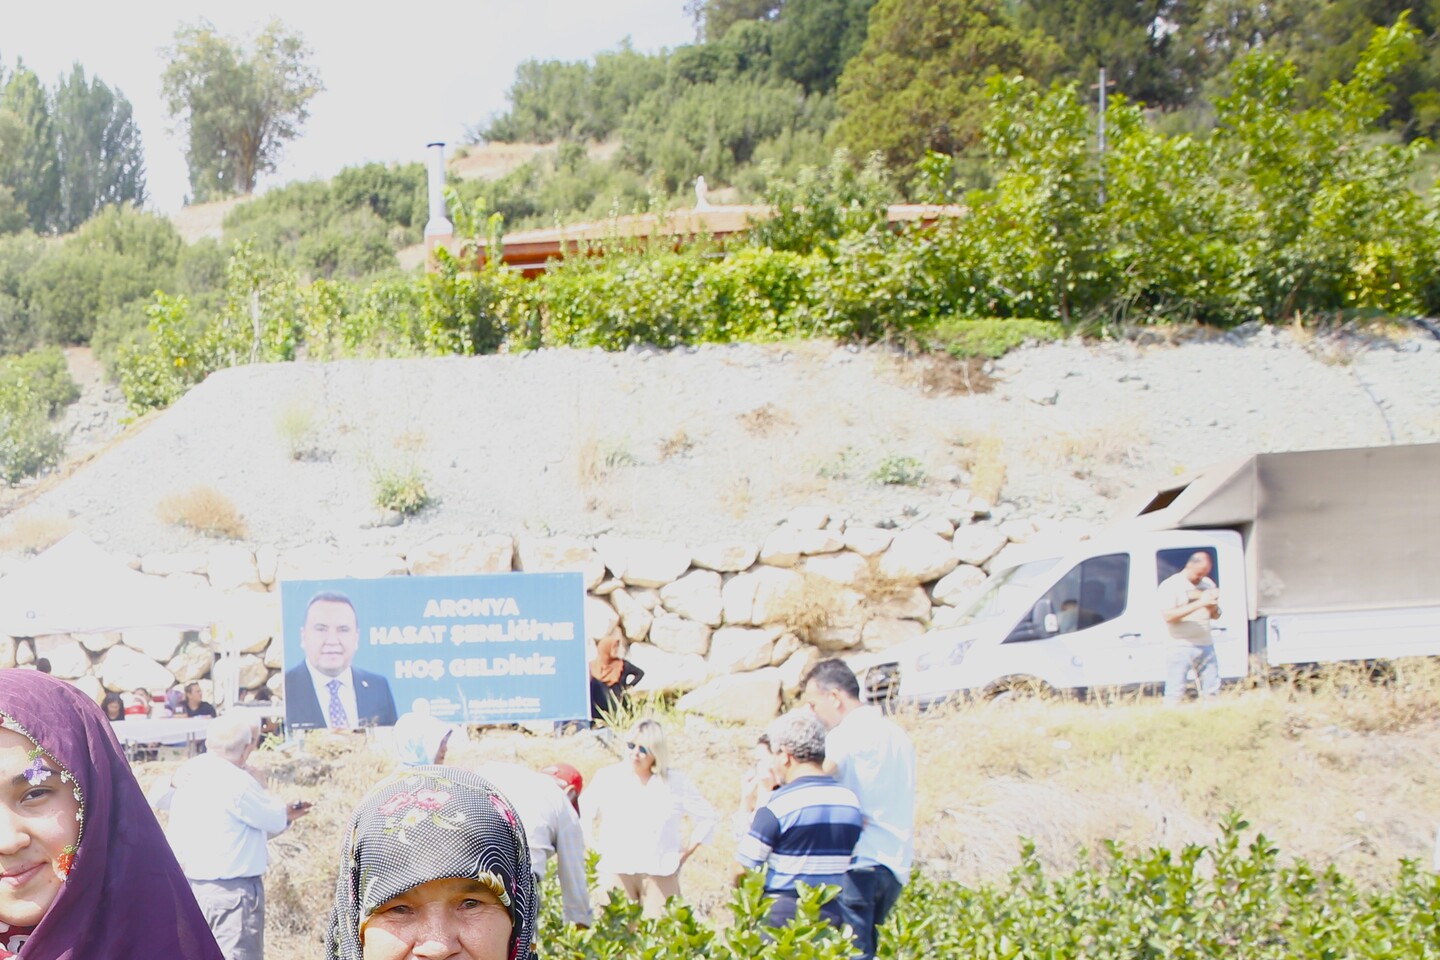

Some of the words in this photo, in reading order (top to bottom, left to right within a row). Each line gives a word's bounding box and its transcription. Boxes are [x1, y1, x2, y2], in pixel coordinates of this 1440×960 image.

[423, 598, 520, 618] ARONYA
[370, 625, 447, 645] HASAT
[395, 659, 445, 680] HOŞ
[448, 653, 556, 677] GELDİNİZ
